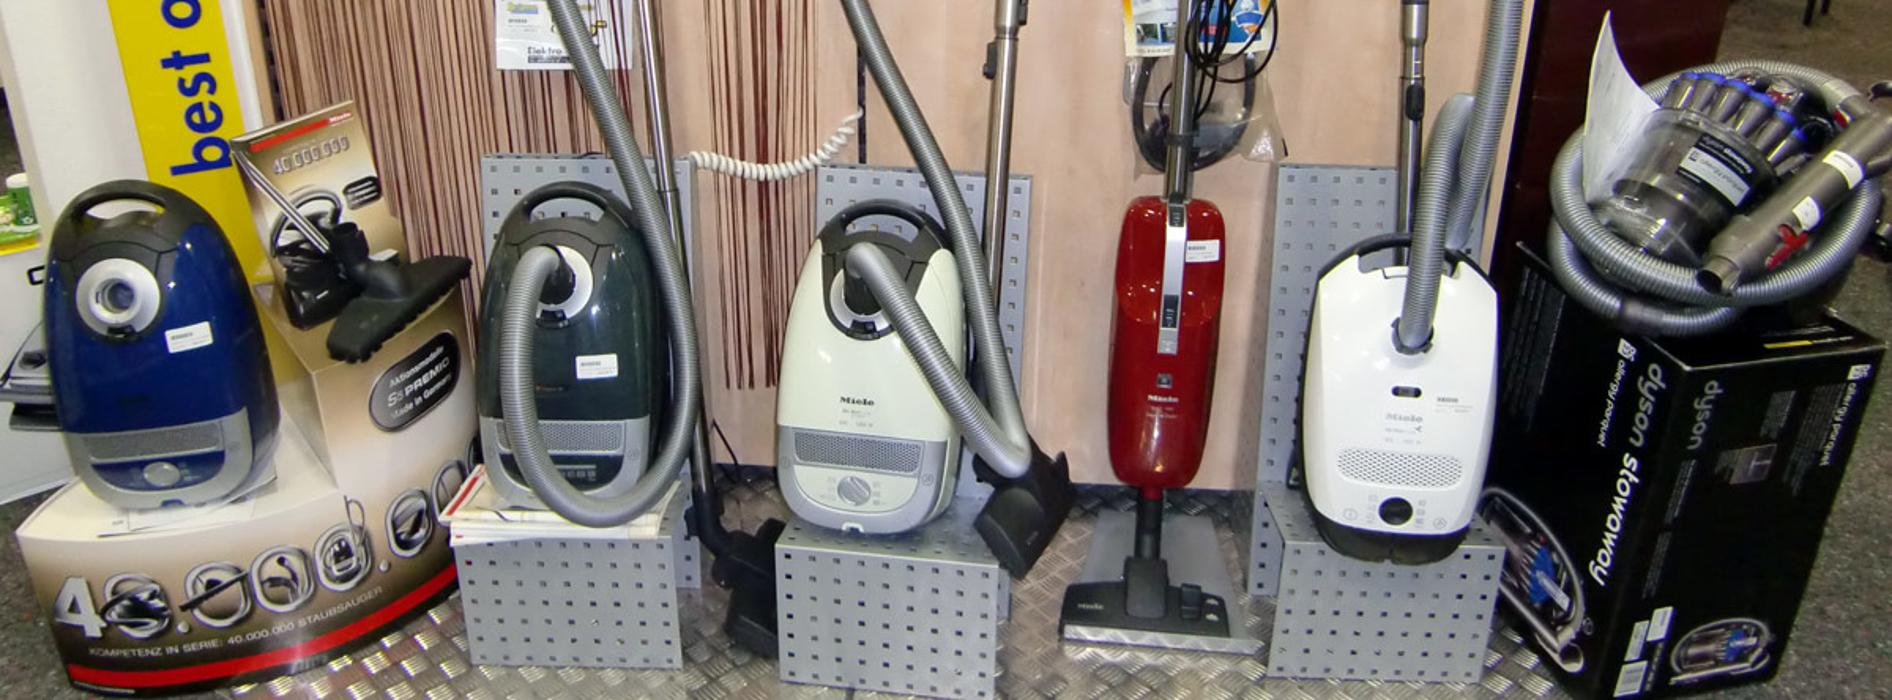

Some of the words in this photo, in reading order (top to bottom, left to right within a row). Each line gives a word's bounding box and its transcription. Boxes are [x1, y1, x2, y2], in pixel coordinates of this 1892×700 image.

[160, 50, 232, 176] best
[404, 357, 450, 397] PREMIO
[839, 396, 875, 406] Miele
[1629, 363, 1666, 448] dyson
[1686, 380, 1724, 450] dyson
[1588, 452, 1640, 587] stowaway
[89, 645, 163, 659] KOMPETENZ
[164, 645, 182, 657] IN
[226, 621, 296, 647] 40.000.000
[296, 585, 384, 629] STAUBSAUGER
